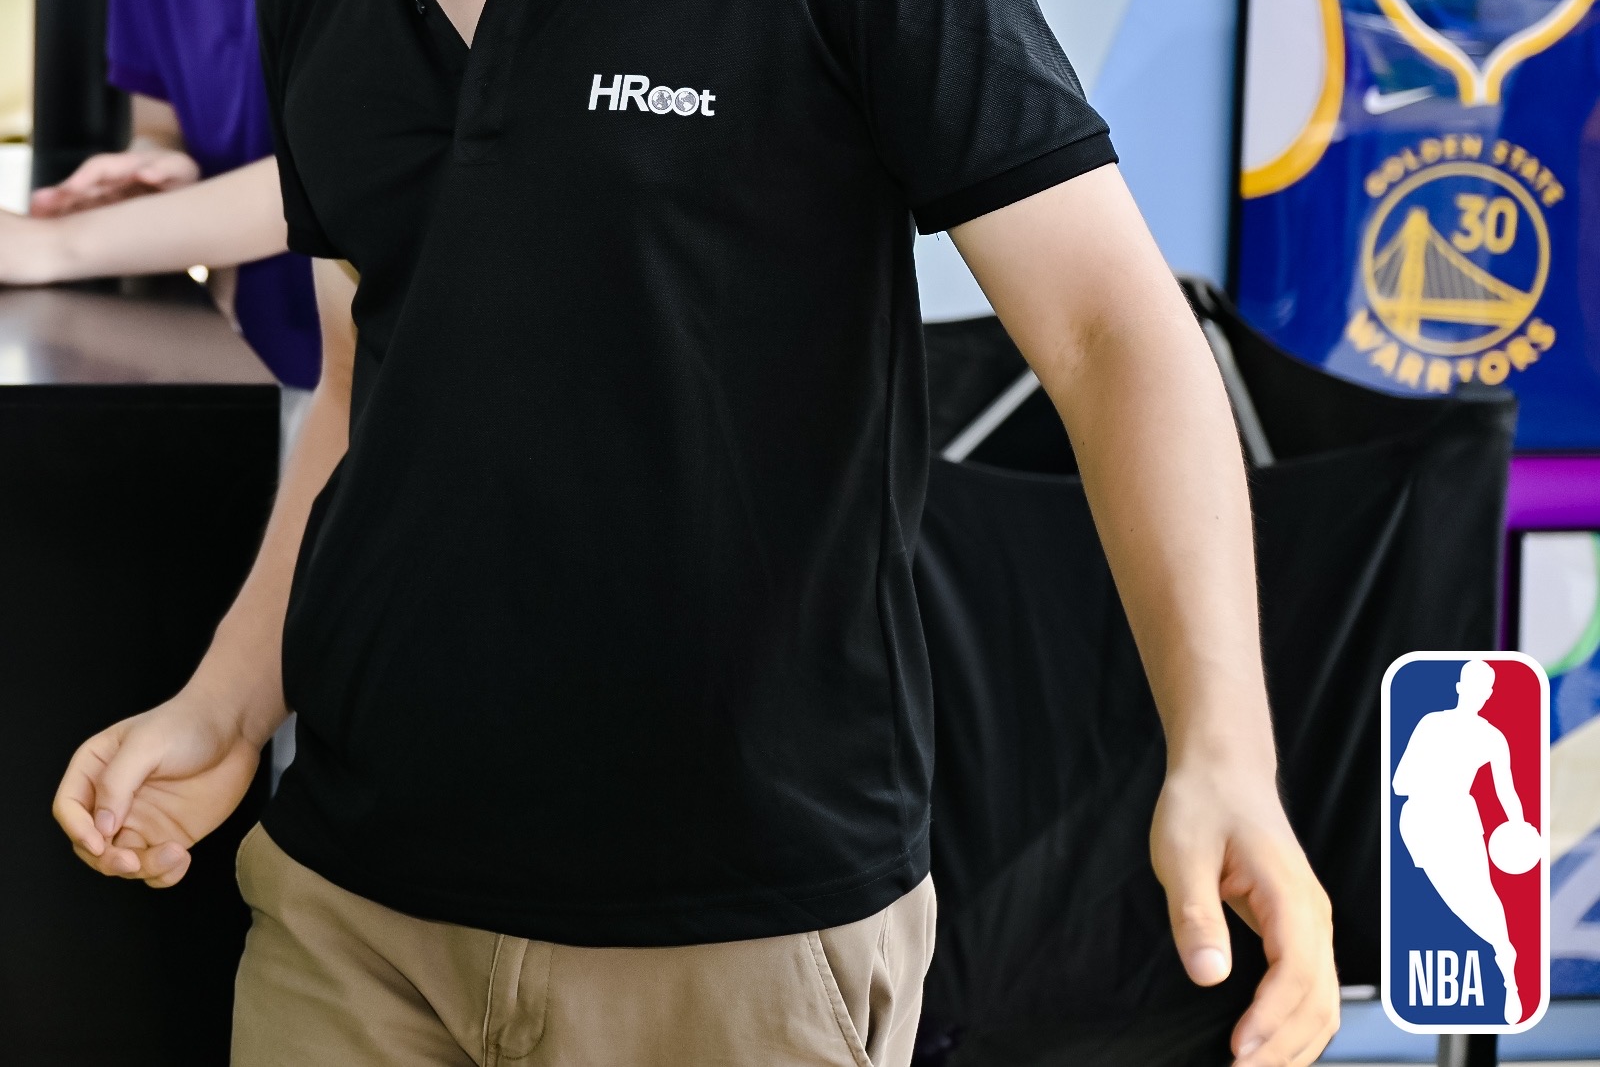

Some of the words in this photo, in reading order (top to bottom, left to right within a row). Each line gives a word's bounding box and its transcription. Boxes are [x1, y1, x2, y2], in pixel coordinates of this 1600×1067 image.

[588, 73, 716, 117] HRoot
[1364, 133, 1483, 199] GOLDEN
[1492, 138, 1566, 208] STATE
[1453, 192, 1518, 255] 30
[1345, 309, 1556, 395] WARRIORS
